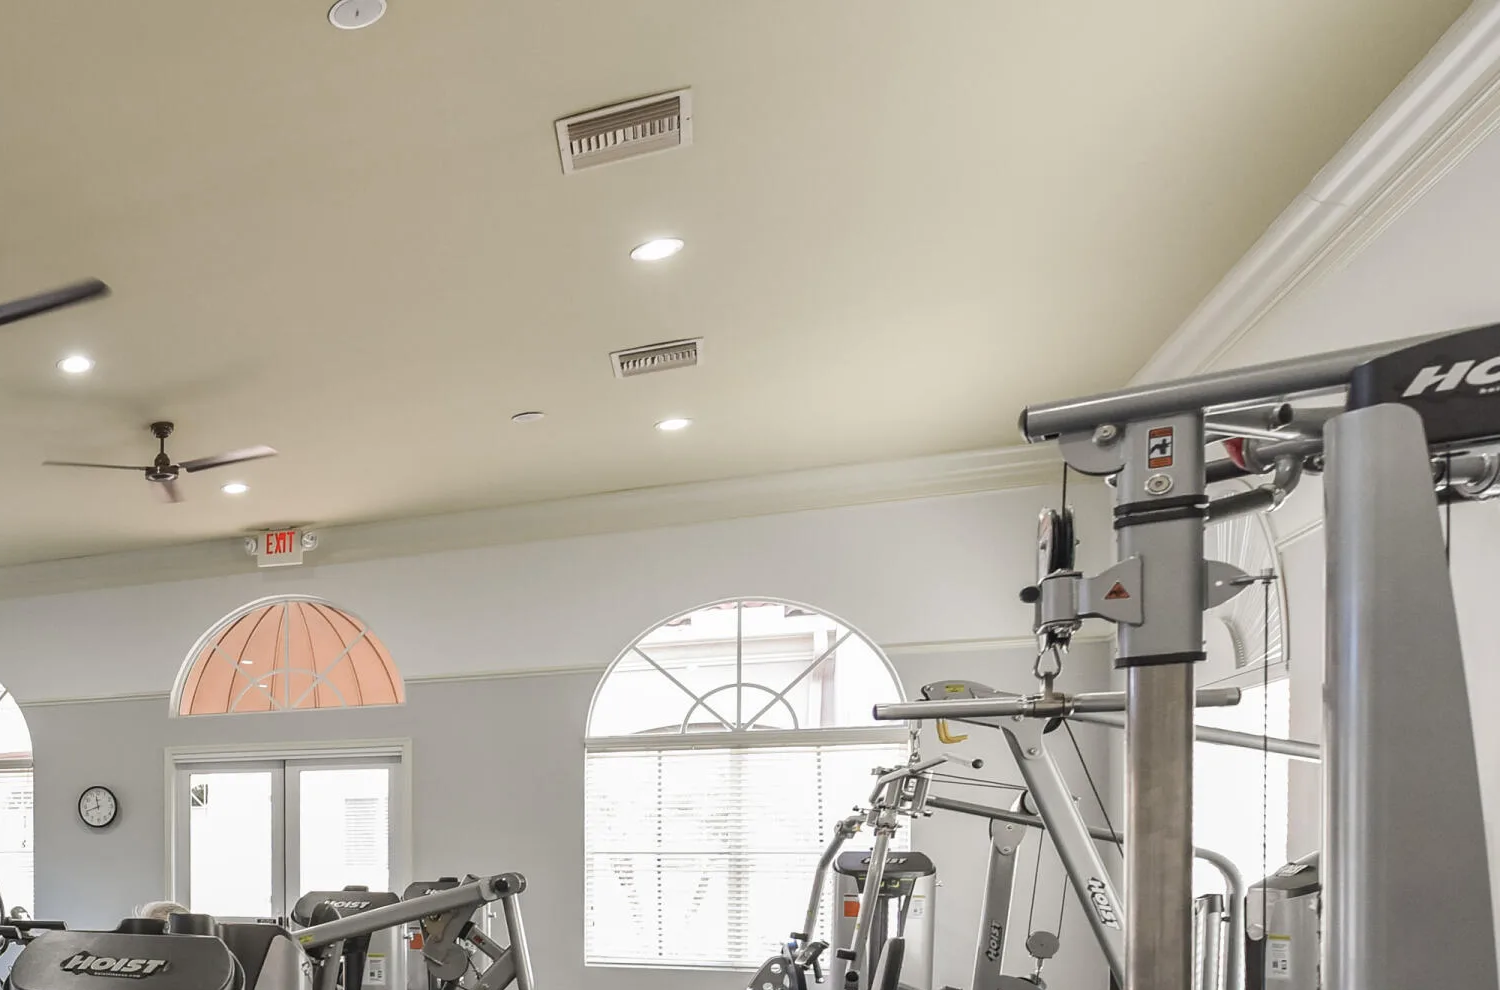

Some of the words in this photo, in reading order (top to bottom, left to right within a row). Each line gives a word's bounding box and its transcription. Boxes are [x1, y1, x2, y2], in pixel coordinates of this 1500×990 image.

[266, 531, 295, 555] EXIT
[1087, 876, 1121, 931] HOIST
[986, 920, 1002, 961] HOIST
[63, 954, 166, 974] HOIST
